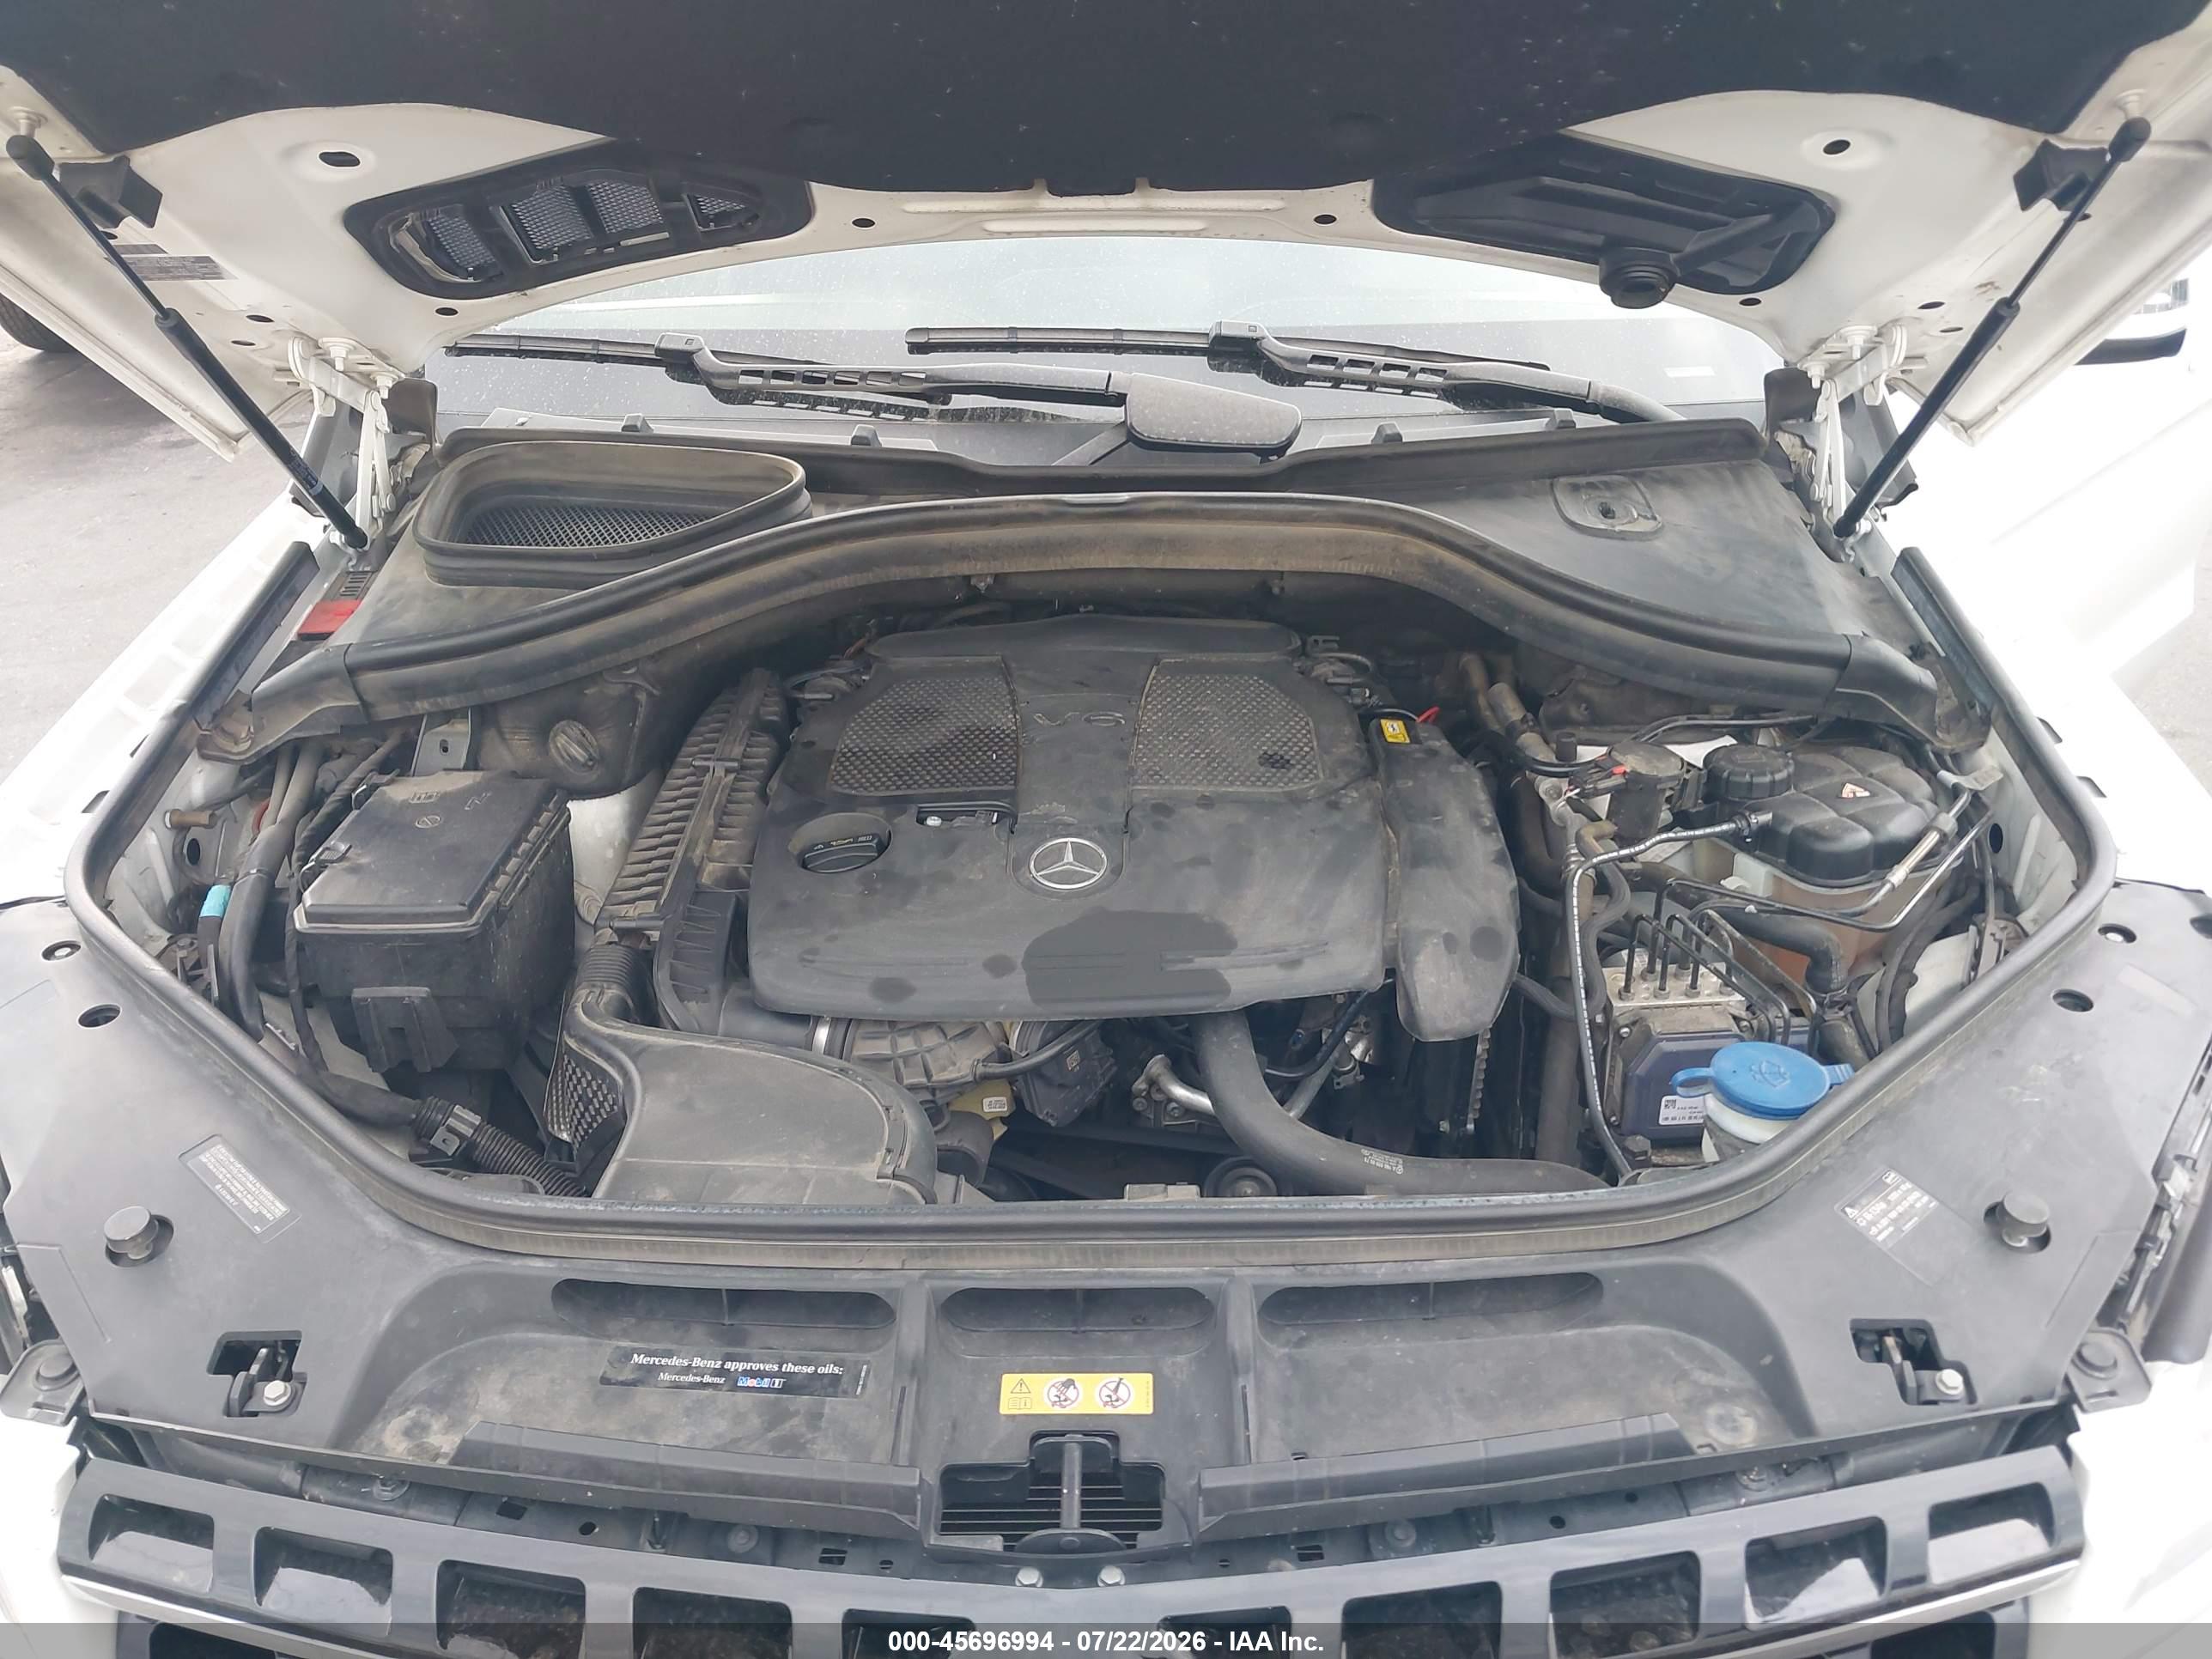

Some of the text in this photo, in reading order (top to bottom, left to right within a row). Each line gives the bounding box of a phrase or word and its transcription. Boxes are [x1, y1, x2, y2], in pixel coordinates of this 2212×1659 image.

[630, 1352, 844, 1375] Mercedes-Benz approves these oils:
[658, 1372, 726, 1383] Mercedes-Benz
[737, 1376, 770, 1388] Mobil
